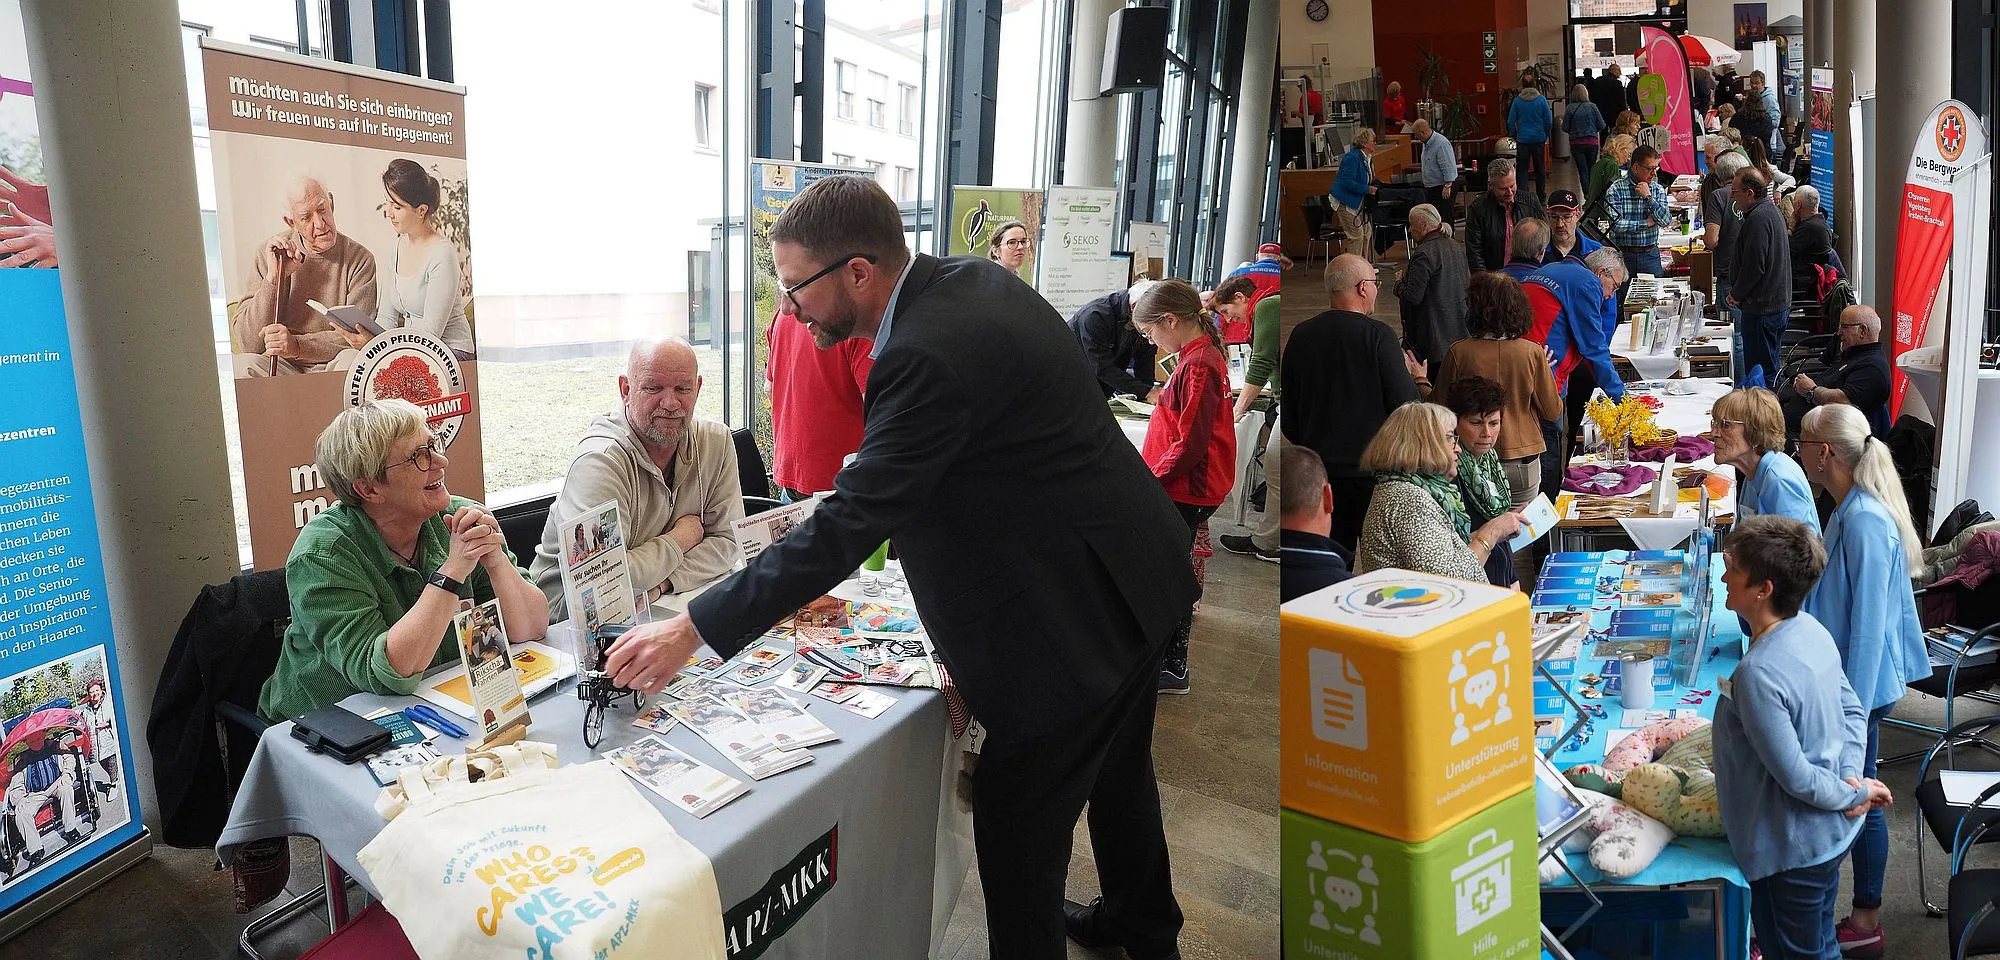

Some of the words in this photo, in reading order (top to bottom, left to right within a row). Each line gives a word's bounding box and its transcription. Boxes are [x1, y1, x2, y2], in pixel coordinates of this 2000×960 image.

[228, 75, 300, 103] möchten
[302, 90, 334, 109] auch
[337, 93, 357, 112] Sie
[360, 98, 384, 116] sich
[387, 103, 453, 127] einbringen?
[231, 99, 263, 119] Wir
[265, 106, 311, 127] freuen
[313, 115, 336, 130] uns
[338, 117, 360, 133] auf
[362, 120, 379, 136] Ihr
[381, 122, 453, 145] Engagement!
[1915, 156, 1927, 170] Die
[1072, 235, 1099, 245] SEKOS
[44, 350, 60, 361] im
[351, 362, 368, 406] ALTEN-
[365, 340, 389, 360] UND
[390, 334, 460, 387] PFLEGEZENTREN
[425, 398, 463, 418] ENAMT
[0, 494, 72, 514] mobilitäts-
[41, 511, 60, 523] die
[33, 527, 71, 543] Leben
[48, 544, 66, 556] sie
[13, 571, 30, 583] an
[32, 562, 64, 578] Orte,
[66, 556, 86, 569] die
[583, 563, 601, 577] suchen
[14, 587, 36, 601] Die
[38, 576, 80, 594] Senio-
[0, 609, 21, 623] der
[24, 588, 91, 615] Umgebung
[20, 606, 88, 635] Inspiration
[12, 640, 37, 655] den
[39, 623, 87, 646] Haaren.
[475, 660, 503, 679] Rikscha-
[1304, 751, 1378, 784] Information
[1445, 736, 1519, 780] Unterstützung
[443, 857, 457, 884] Dein
[456, 871, 466, 883] in
[475, 844, 551, 885] WHO
[476, 846, 596, 937] CARES?
[726, 848, 829, 954] APZ-MKK
[515, 886, 572, 926] WE
[610, 898, 640, 951] APZ-MKK
[1473, 932, 1498, 957] Hilfe
